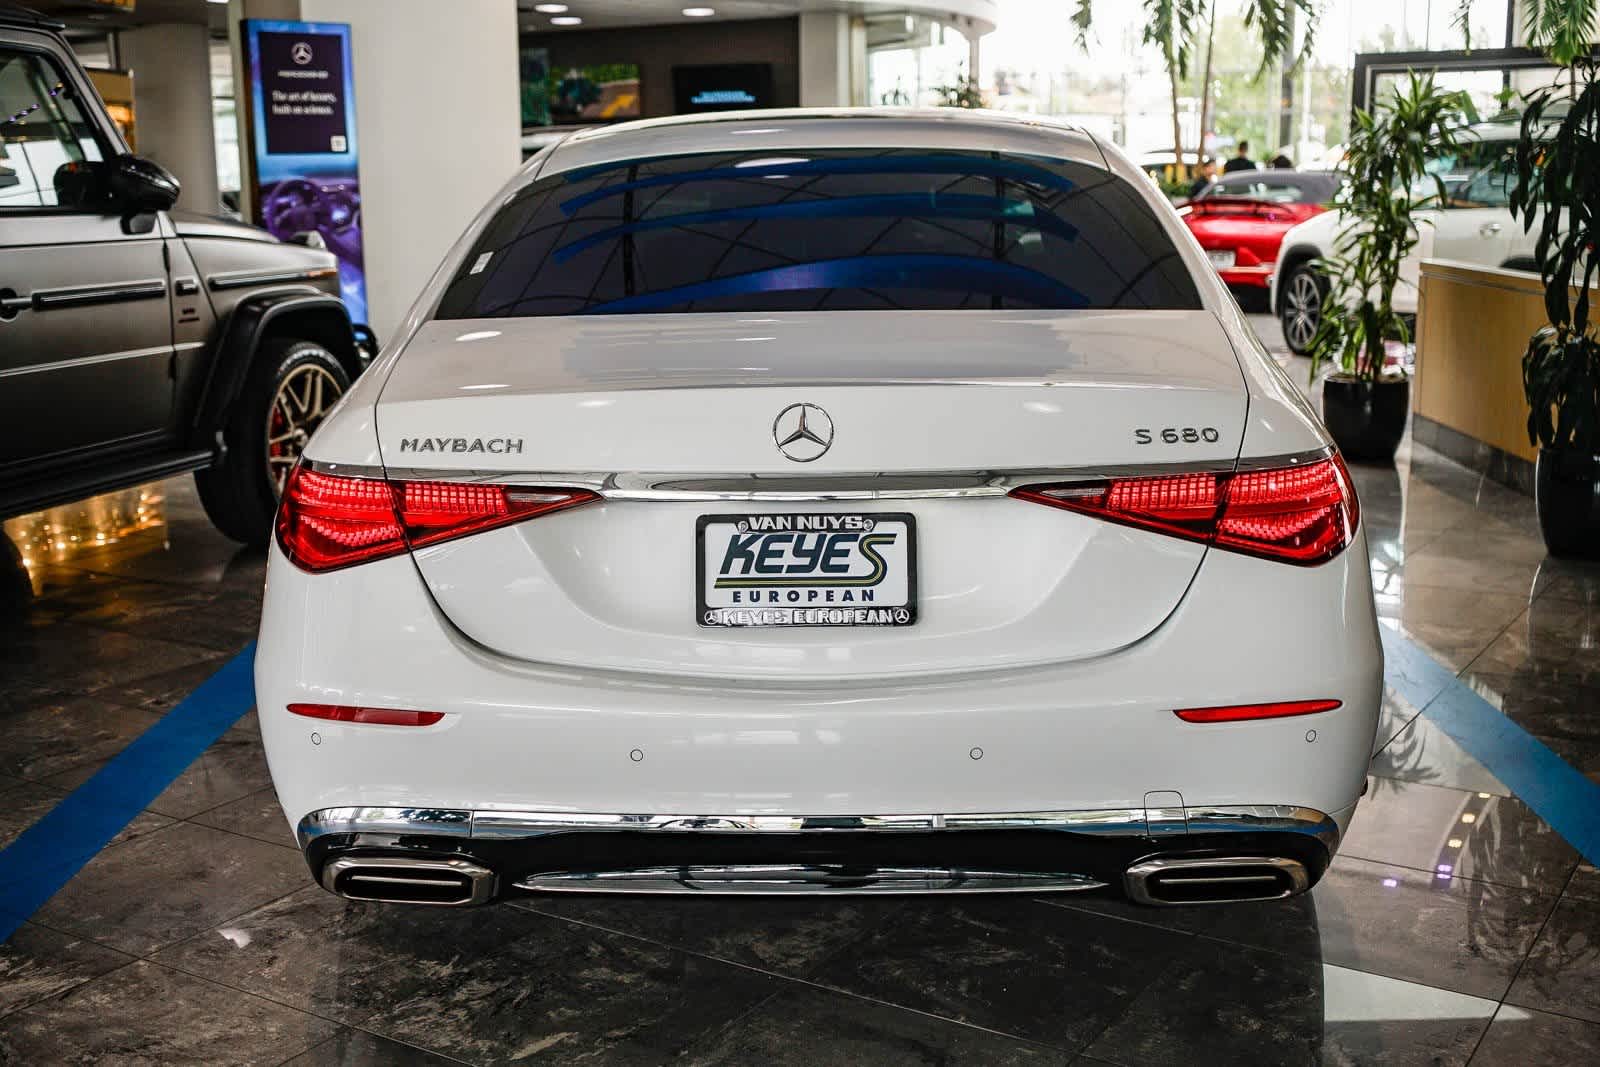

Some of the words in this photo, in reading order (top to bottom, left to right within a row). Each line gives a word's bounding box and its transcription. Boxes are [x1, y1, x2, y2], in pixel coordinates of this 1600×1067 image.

[1134, 428, 1152, 445] S
[1161, 427, 1219, 444] 680
[400, 438, 523, 454] MAYBACH
[748, 516, 792, 530] VAN
[797, 515, 863, 530] NUYS
[714, 533, 898, 587] KEYES
[732, 589, 874, 603] EUROPEAN
[723, 609, 789, 625] KEYES
[794, 608, 894, 624] EUROPEAN
